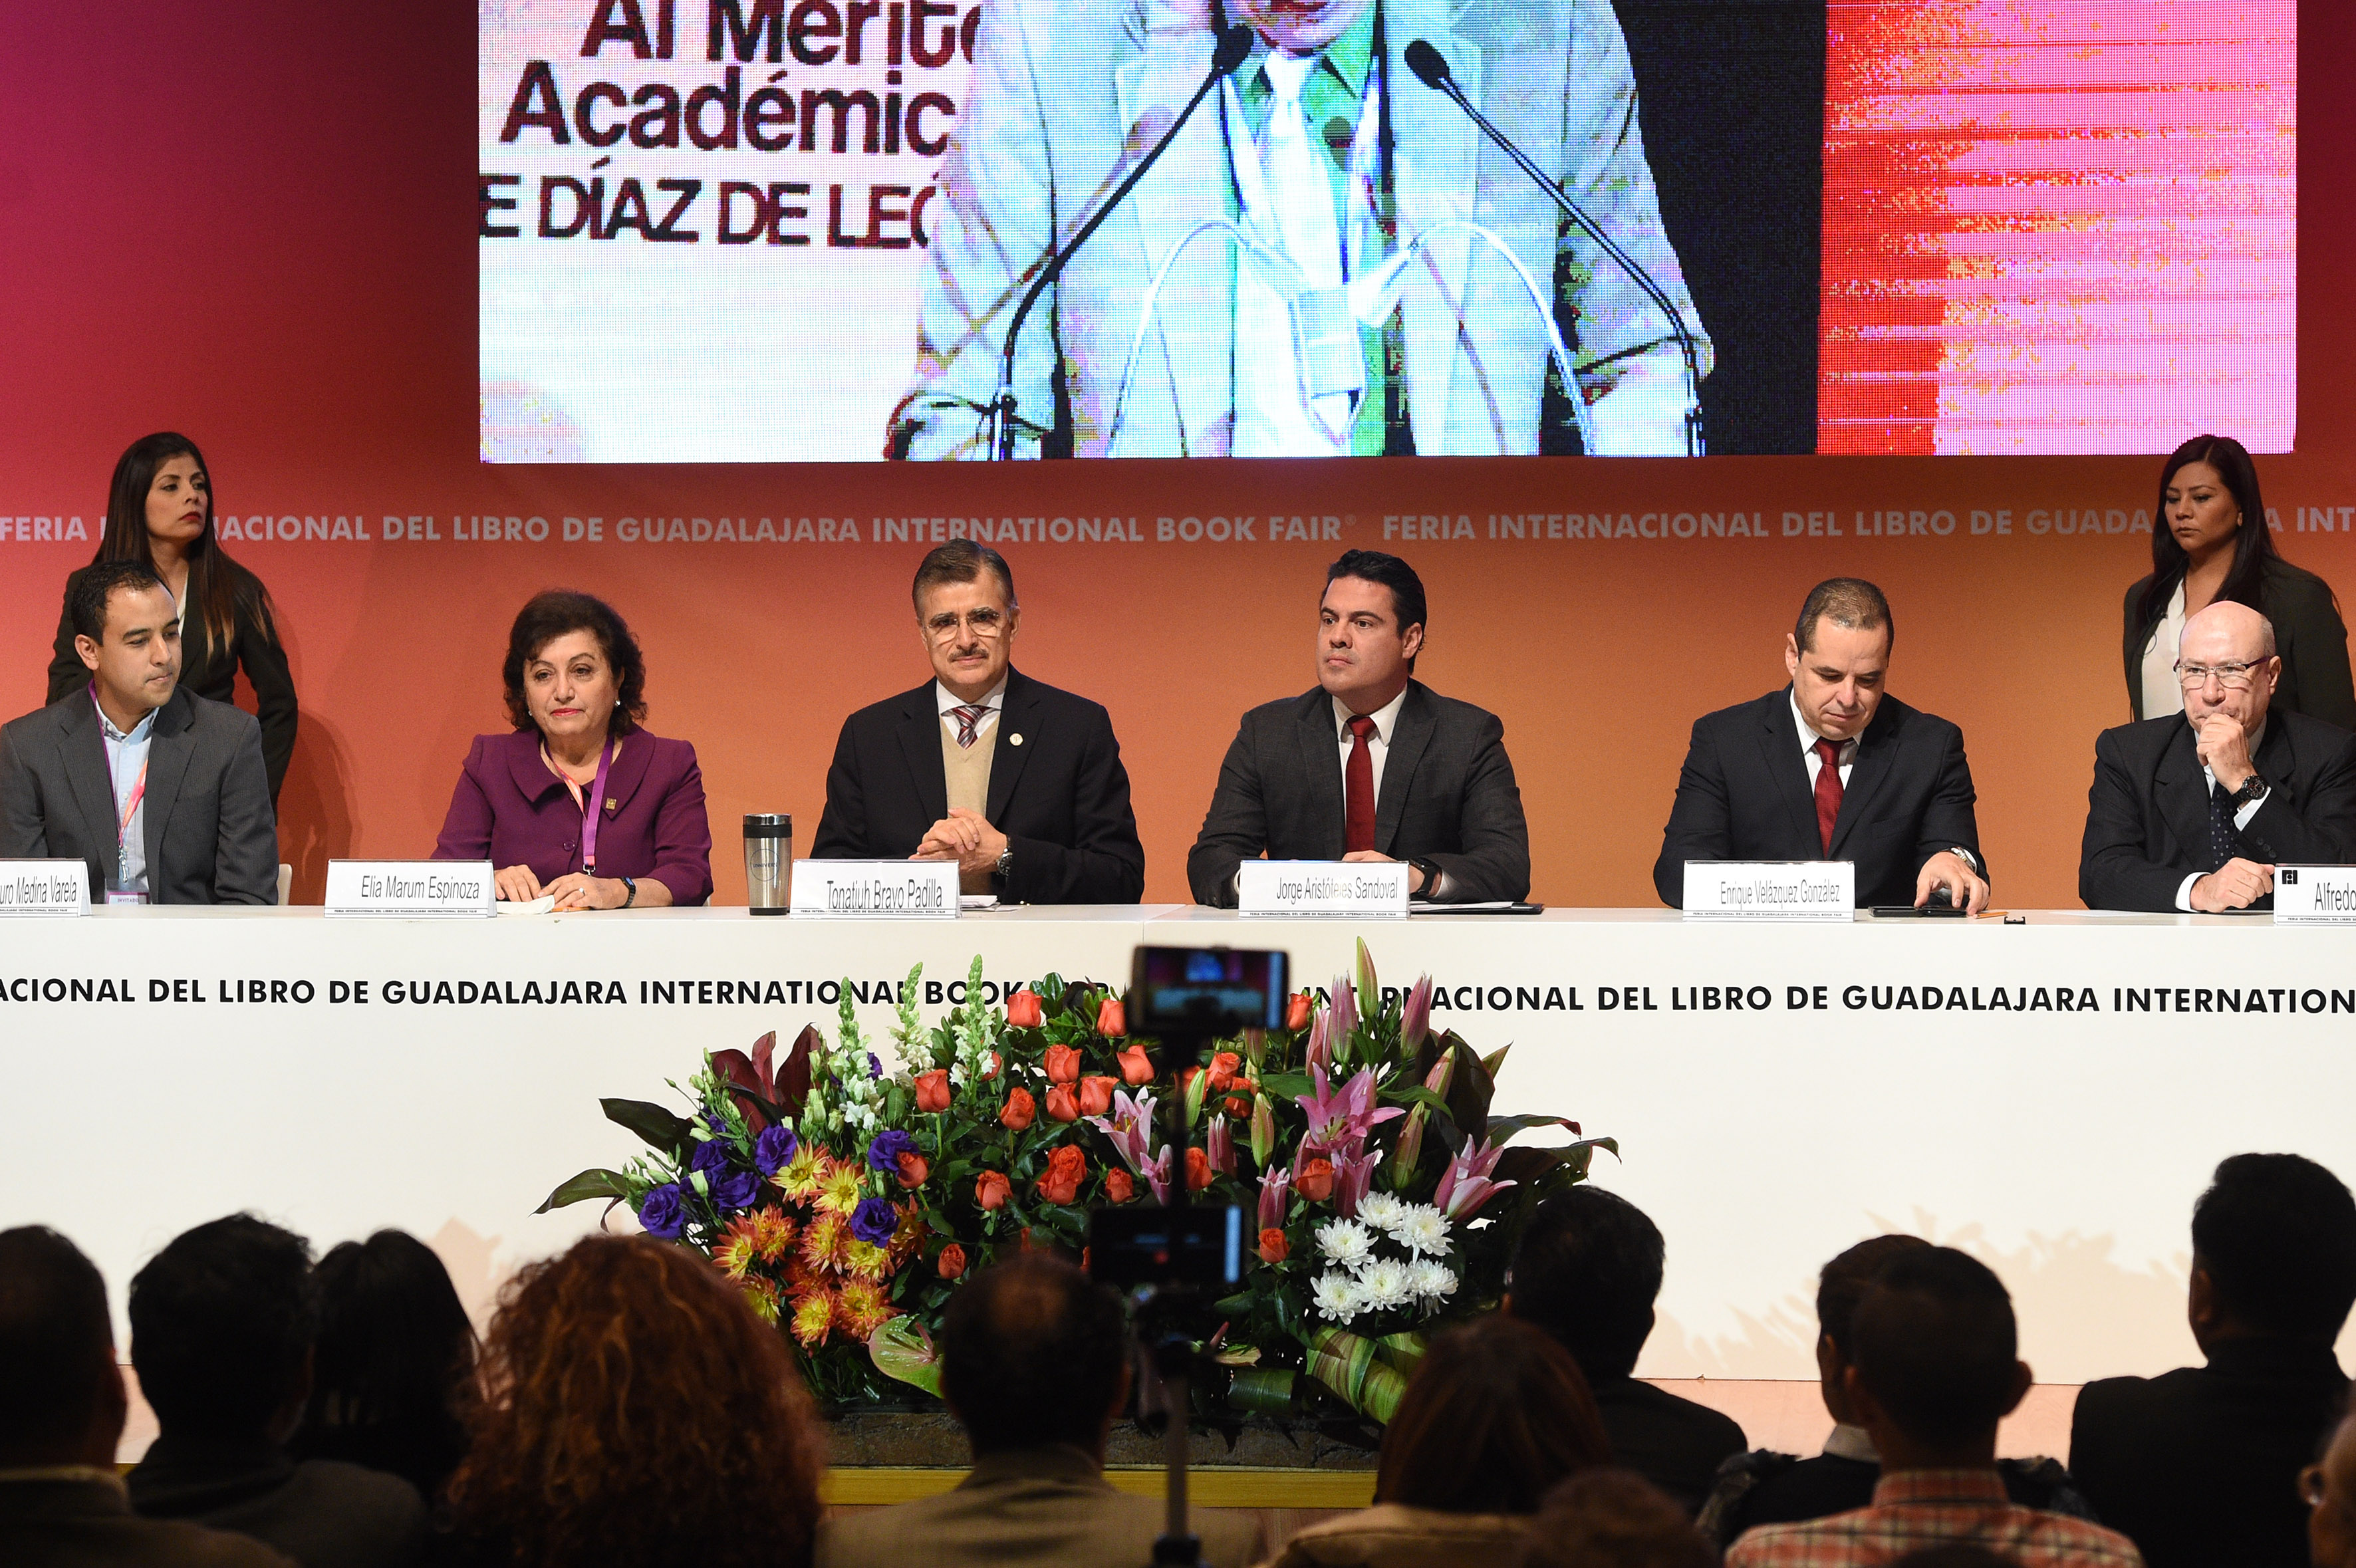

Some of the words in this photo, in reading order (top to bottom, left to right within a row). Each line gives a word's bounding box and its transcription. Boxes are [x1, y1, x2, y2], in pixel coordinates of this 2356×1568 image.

[479, 174, 521, 237] E
[538, 156, 702, 242] DÍAZ
[718, 181, 810, 245] DE
[0, 515, 88, 542] FERIA
[382, 515, 441, 541] DEL
[454, 515, 549, 542] LIBRO
[563, 517, 603, 542] DE
[616, 517, 860, 543] GUADALAJARA
[872, 517, 1144, 543] INTERNATIONAL
[1156, 517, 1256, 542] BOOK
[1383, 515, 1476, 541] FERIA
[1489, 513, 1769, 539] INTERNACIONAL
[1782, 511, 1843, 537] DEL
[1856, 511, 1956, 536] LIBRO
[1970, 511, 2012, 535] DE
[2297, 507, 2356, 533] INT
[16, 876, 47, 904] Medina
[51, 875, 77, 903] Varela
[362, 875, 382, 898] Elia
[386, 875, 425, 898] Marum
[428, 876, 479, 904] Espinoza
[827, 880, 870, 908] Tonatiuh
[874, 880, 904, 908] Bravo
[908, 878, 942, 908] Padilla
[1276, 877, 1302, 905] Jorge
[1355, 876, 1398, 899] Sandoval
[1721, 881, 1752, 910] Enrique
[1755, 880, 1797, 910] Velázquez
[1801, 878, 1840, 903] González
[2314, 882, 2356, 911] Alfredo
[150, 979, 206, 1003] DEL
[220, 980, 315, 1003] LIBRO
[330, 981, 368, 1003] DE
[382, 981, 627, 1004] GUADALAJARA
[1599, 987, 1658, 1010] DEL
[1672, 986, 1771, 1010] LIBRO
[1787, 986, 1828, 1010] DE
[1843, 985, 2100, 1011] GUADALAJARA
[2115, 988, 2355, 1013] INTERNATION
